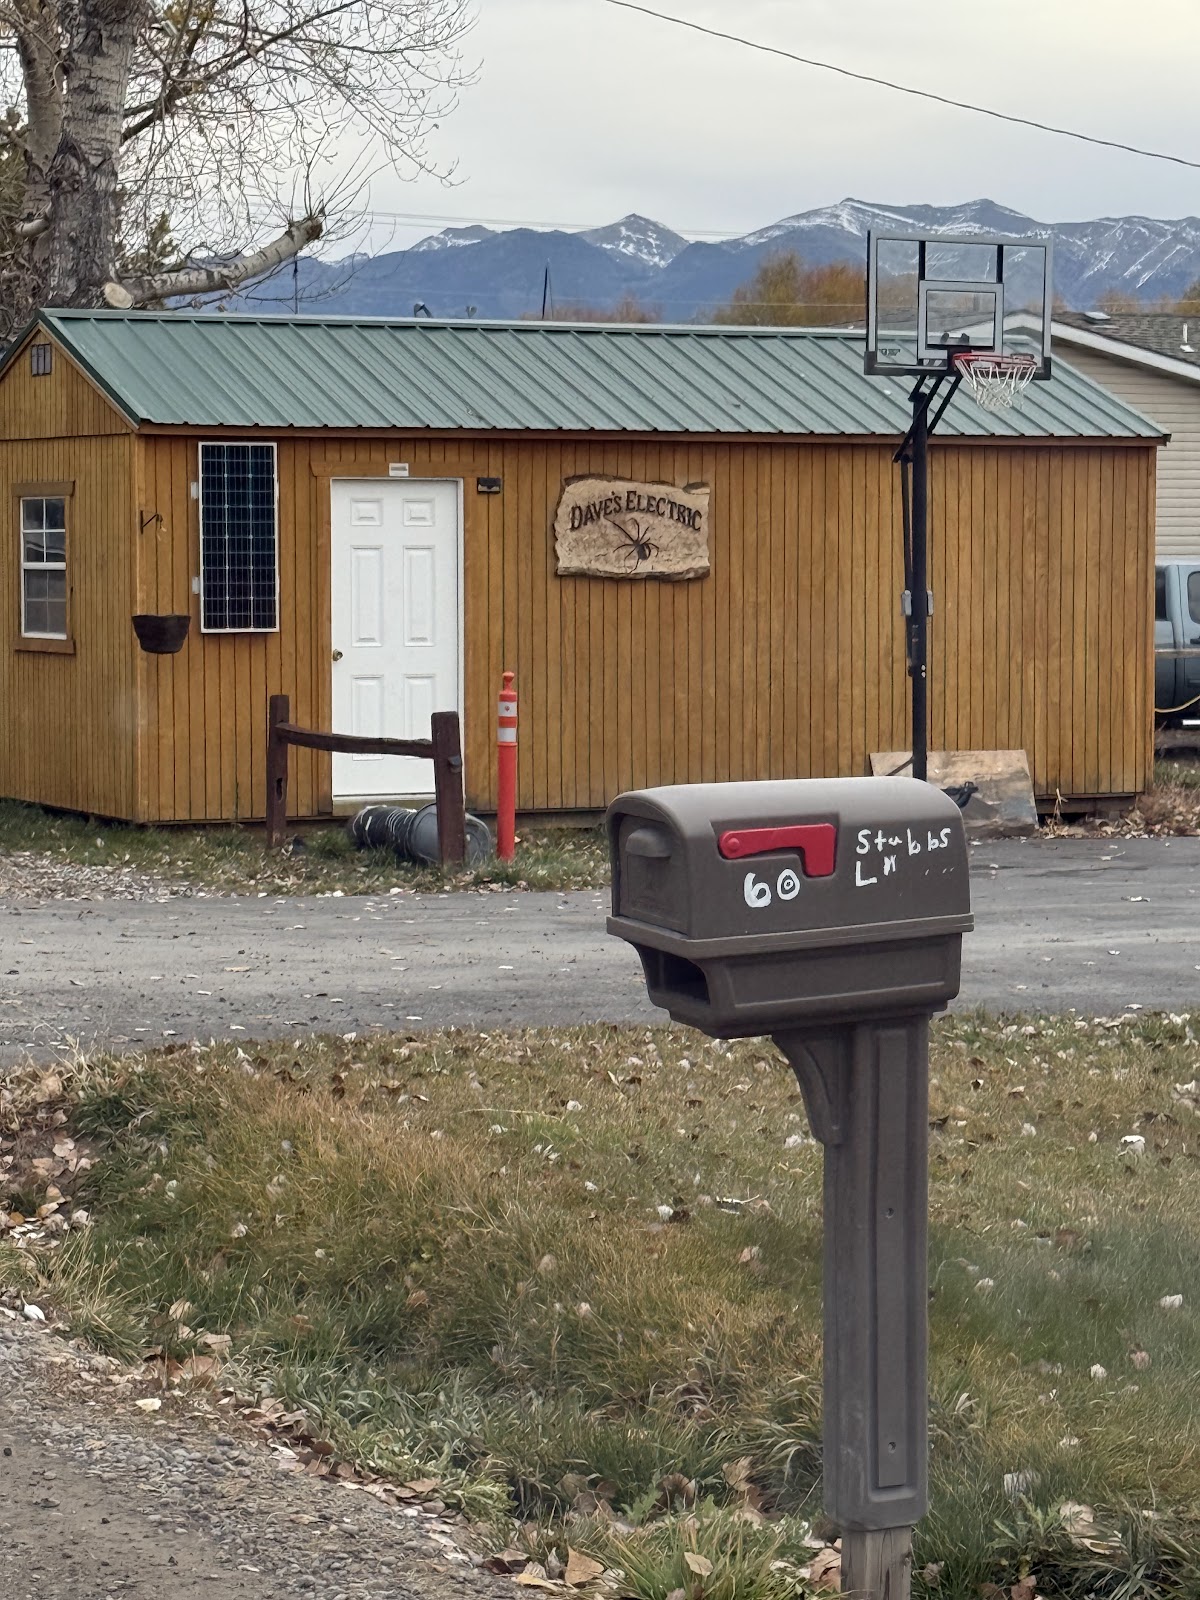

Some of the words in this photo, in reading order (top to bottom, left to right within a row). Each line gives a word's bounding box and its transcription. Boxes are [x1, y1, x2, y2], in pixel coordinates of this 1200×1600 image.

[569, 491, 622, 531] DAVE'S
[625, 490, 703, 531] ELECTRIC
[744, 868, 800, 908] 60
